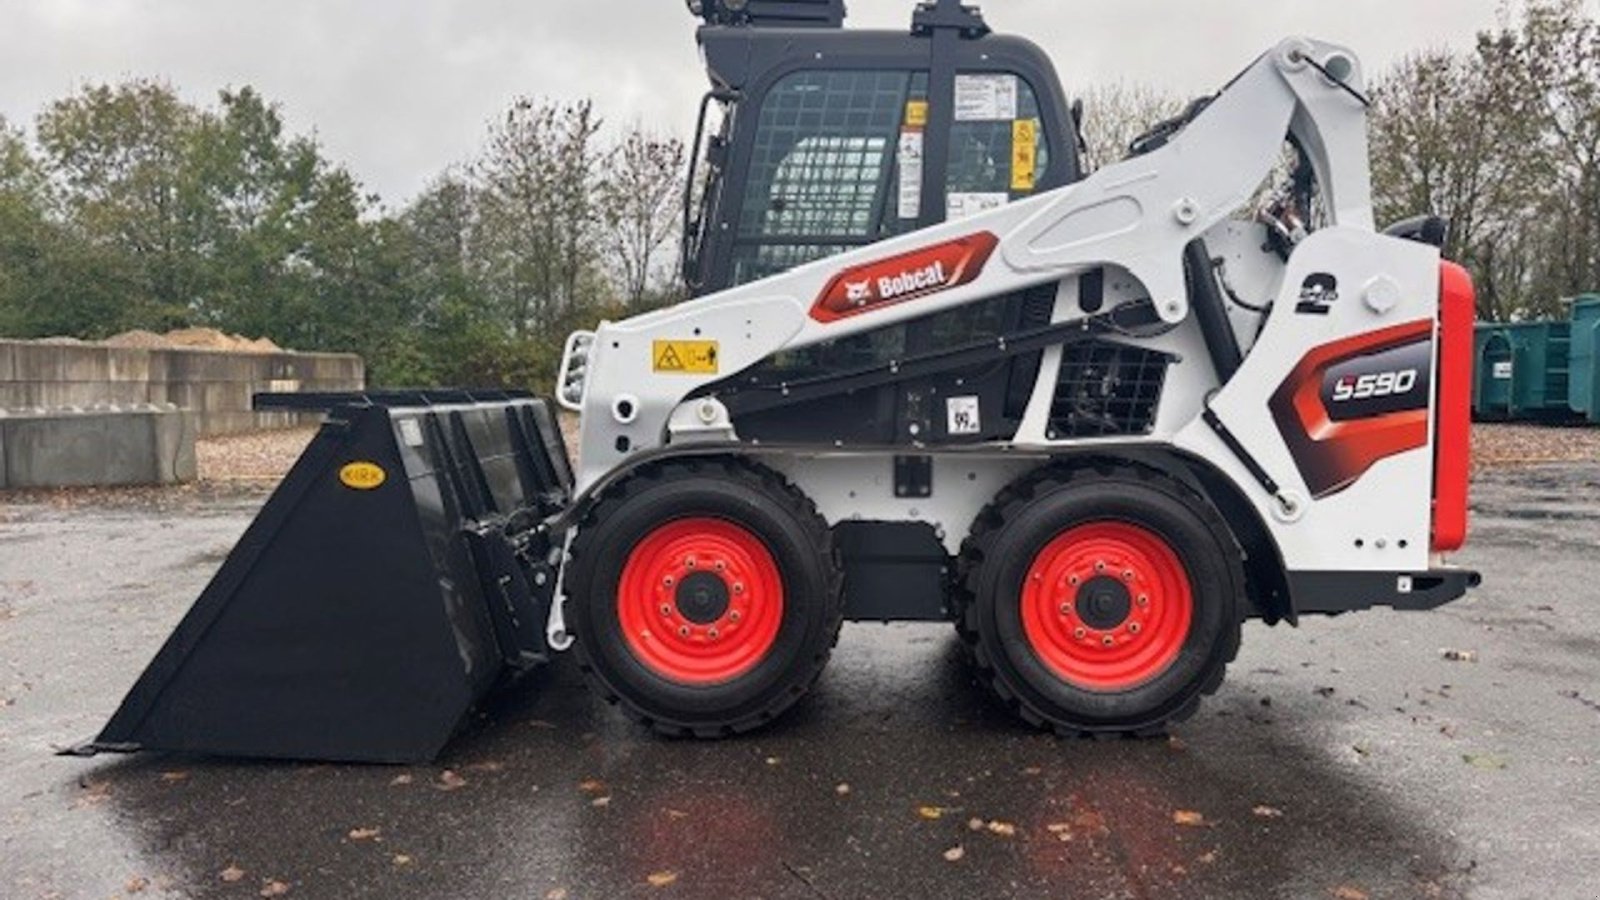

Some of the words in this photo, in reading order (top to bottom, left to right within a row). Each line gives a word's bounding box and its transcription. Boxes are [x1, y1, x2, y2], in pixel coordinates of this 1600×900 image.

[878, 262, 945, 298] Bobcat
[1295, 272, 1337, 314] 2
[1332, 369, 1417, 401] S590
[344, 467, 381, 483] KIRK
